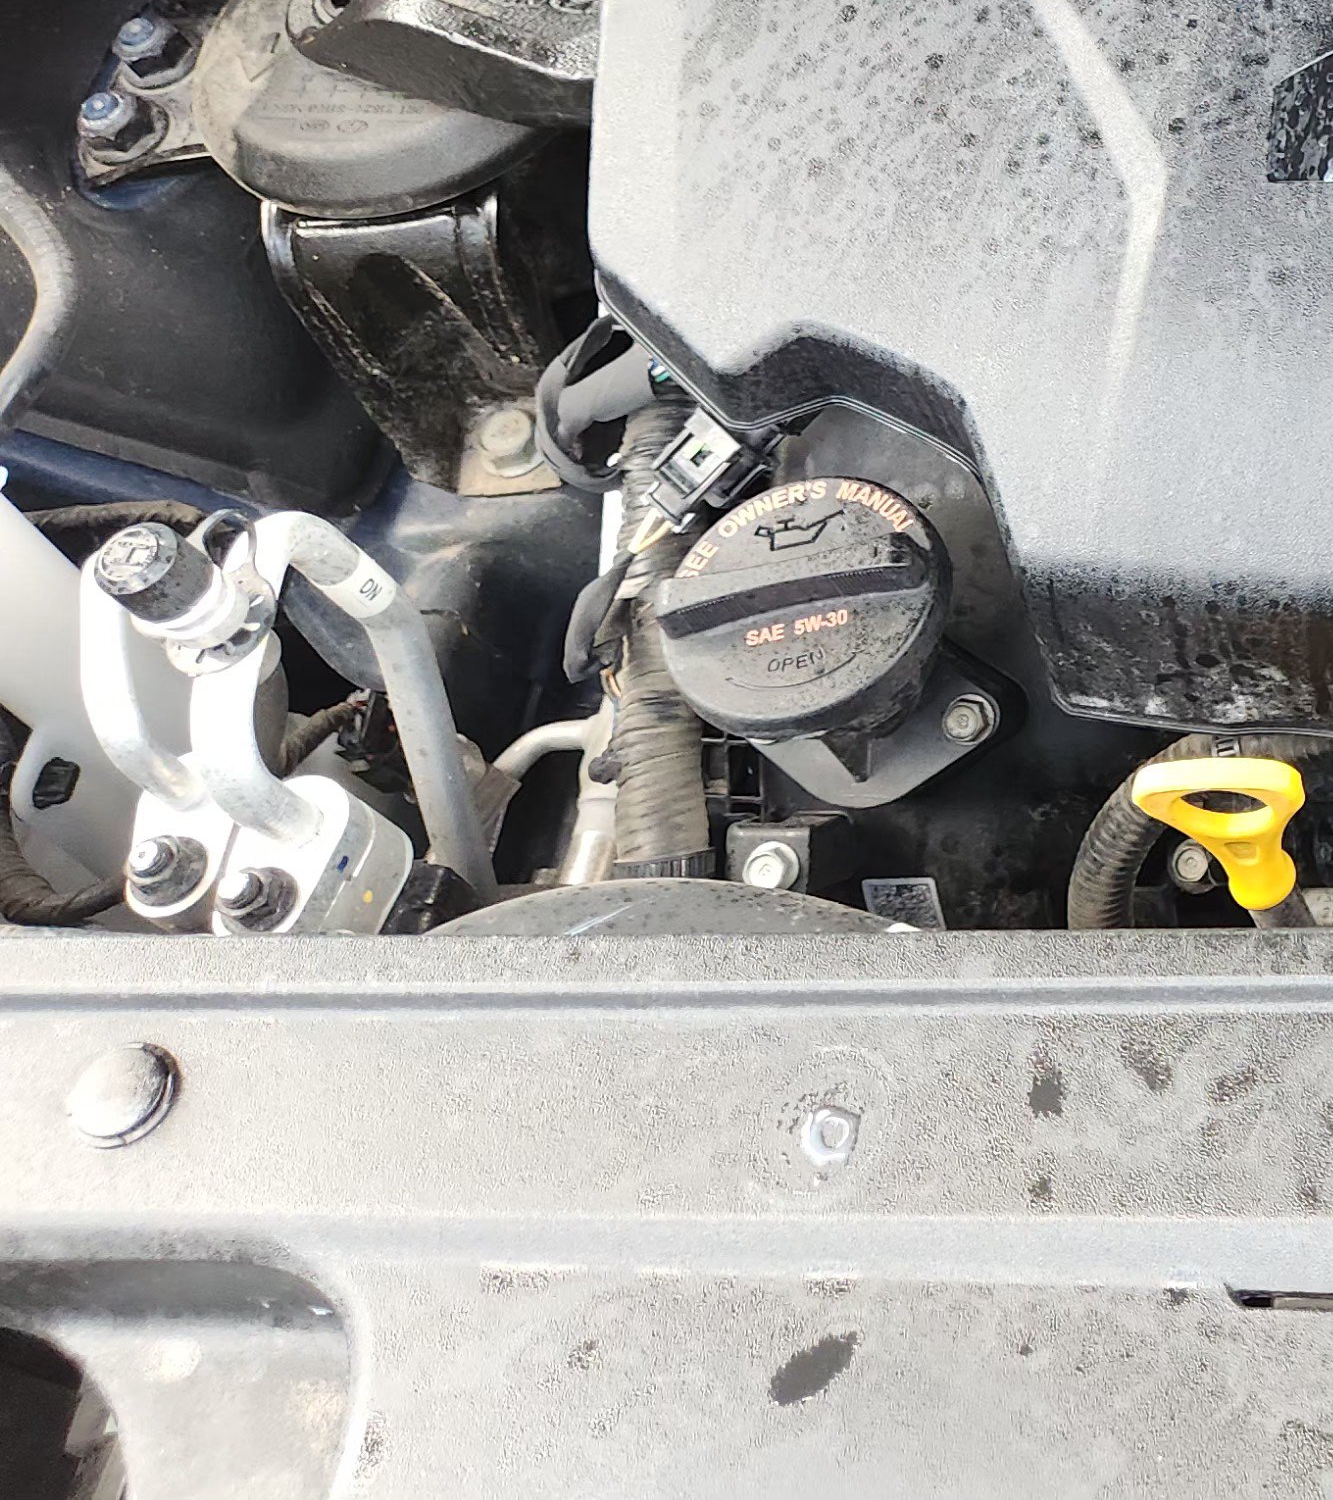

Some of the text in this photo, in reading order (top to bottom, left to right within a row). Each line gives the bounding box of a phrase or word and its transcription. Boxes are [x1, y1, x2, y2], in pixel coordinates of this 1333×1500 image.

[718, 480, 828, 538] OWNER'S
[745, 609, 849, 646] SAE 5W-30
